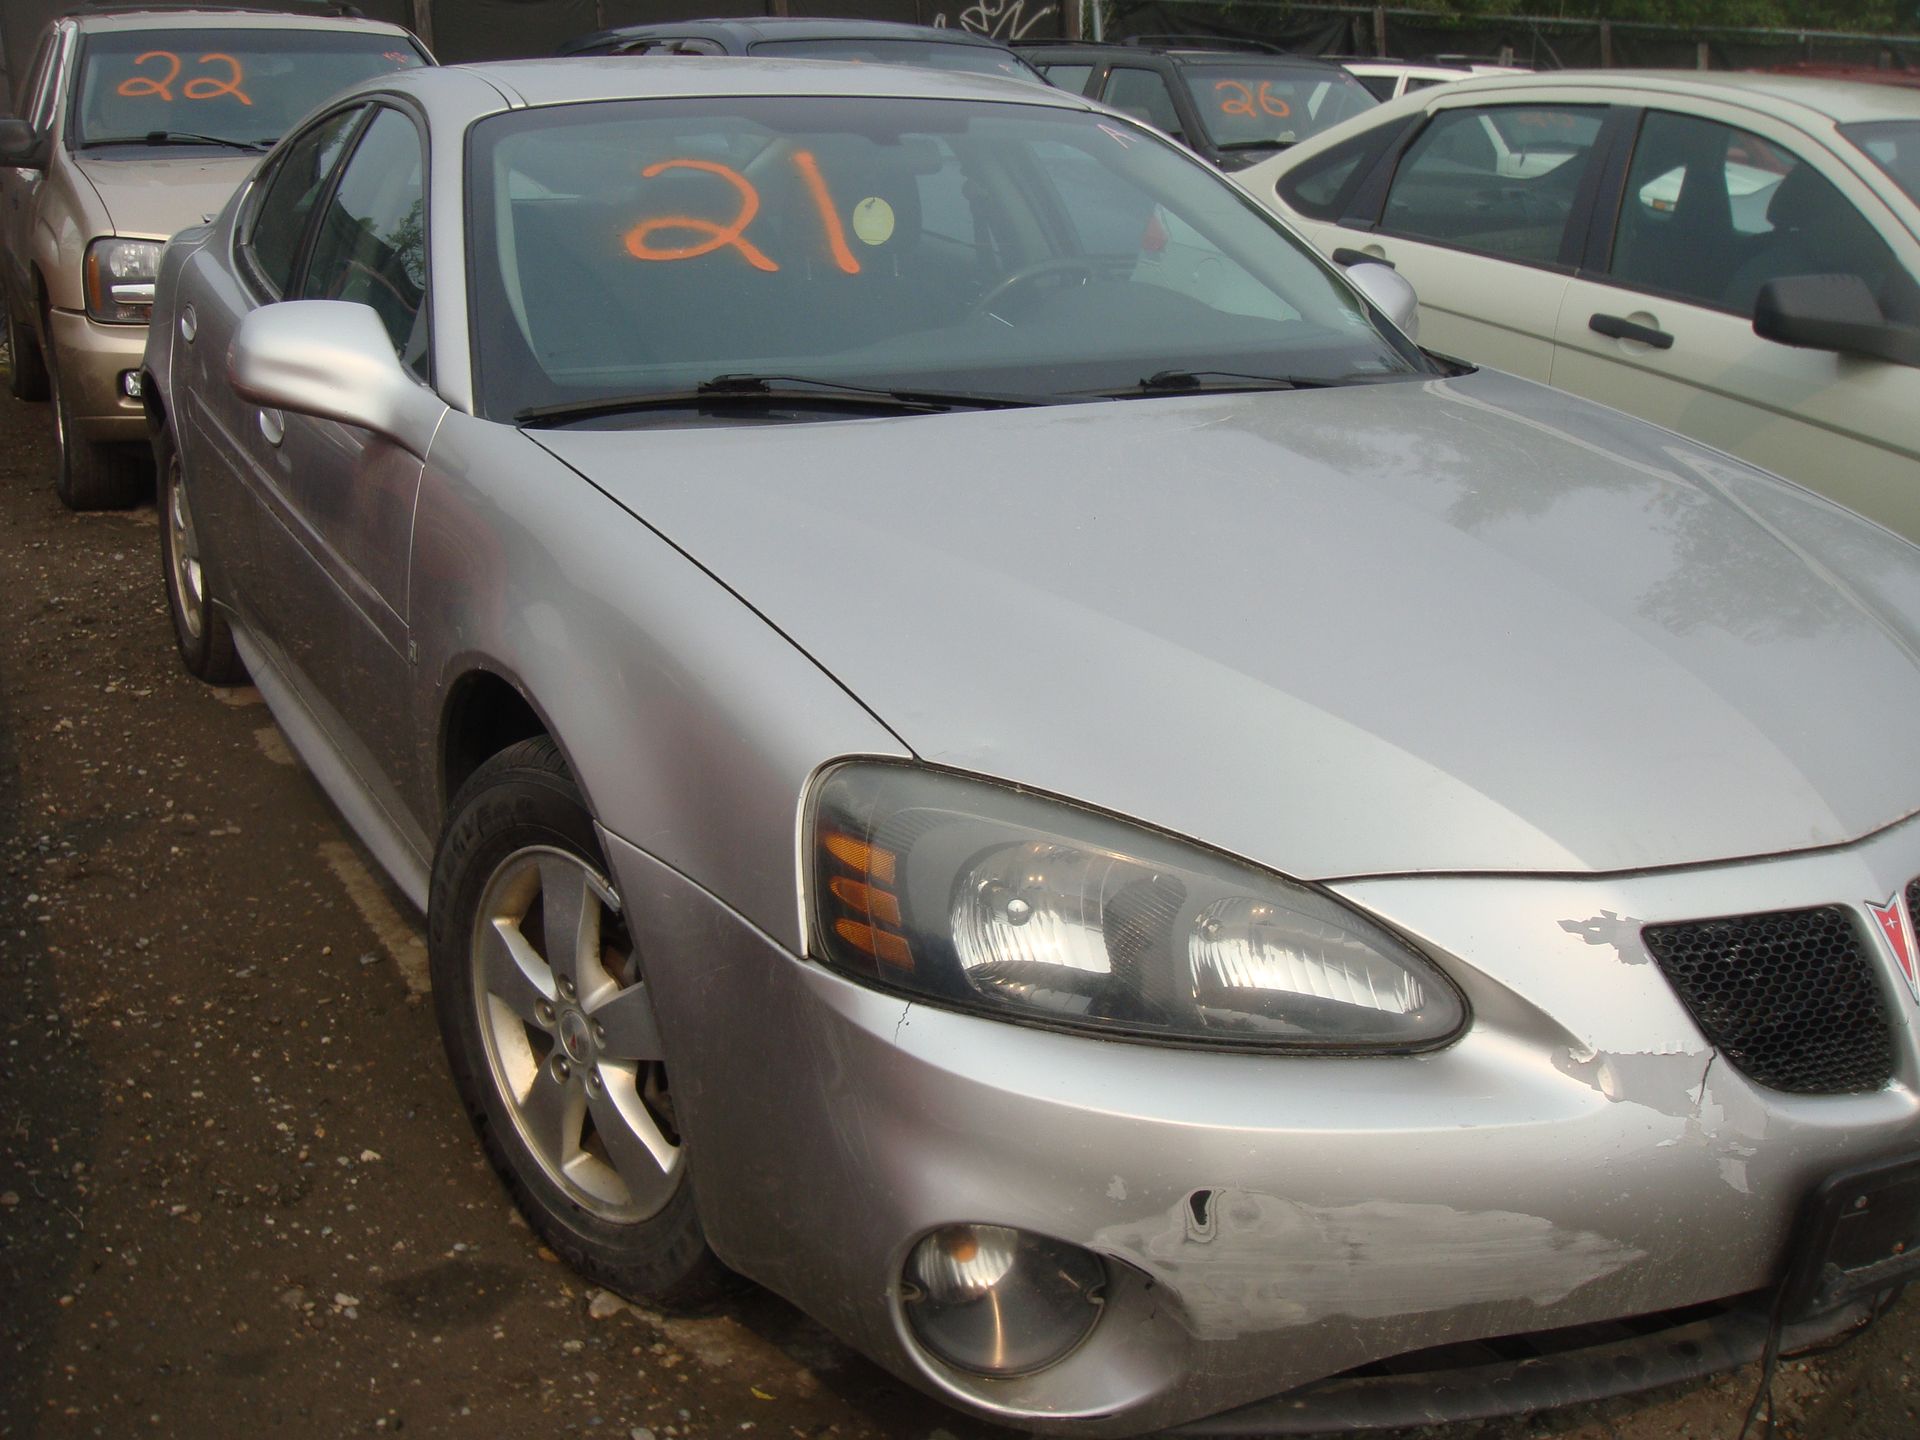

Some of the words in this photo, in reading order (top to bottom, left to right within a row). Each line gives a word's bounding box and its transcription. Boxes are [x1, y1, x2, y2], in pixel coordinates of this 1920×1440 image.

[117, 50, 252, 105] 22
[1215, 80, 1291, 119] 26
[623, 150, 861, 275] 21
